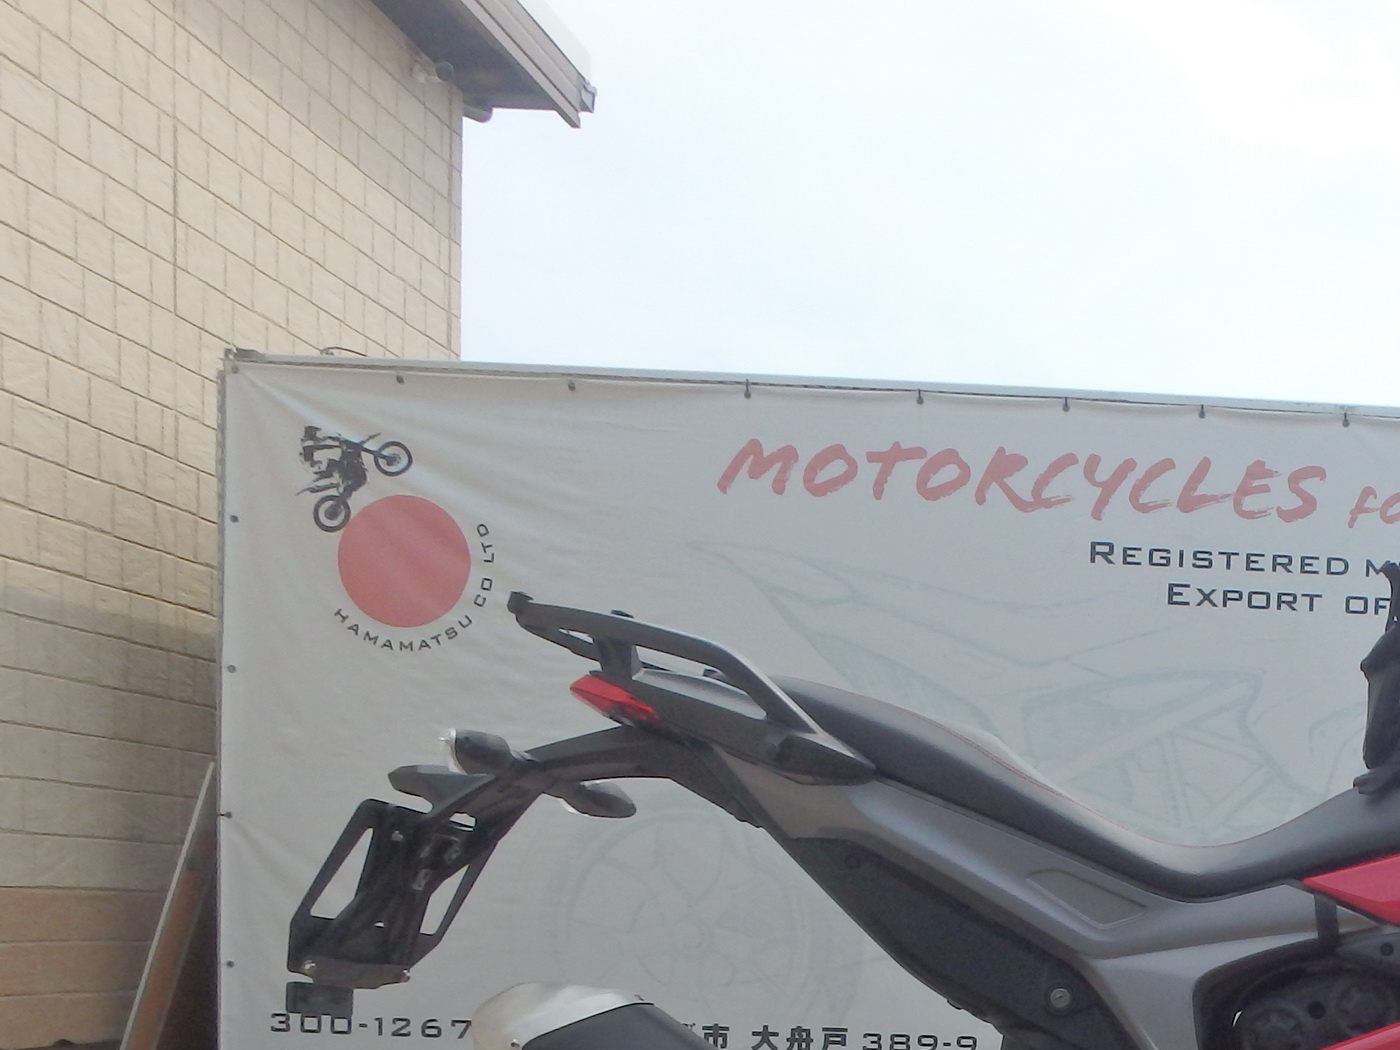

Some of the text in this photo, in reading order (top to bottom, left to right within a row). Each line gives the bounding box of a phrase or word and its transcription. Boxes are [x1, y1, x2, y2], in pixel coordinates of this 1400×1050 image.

[717, 437, 1328, 523] MOTORCYCLES
[1089, 541, 1349, 576] REGISTERED
[333, 522, 495, 652] HAMAMATSU CO LTD
[1167, 582, 1323, 613] EXPORT
[270, 1003, 472, 1040] 300-1267
